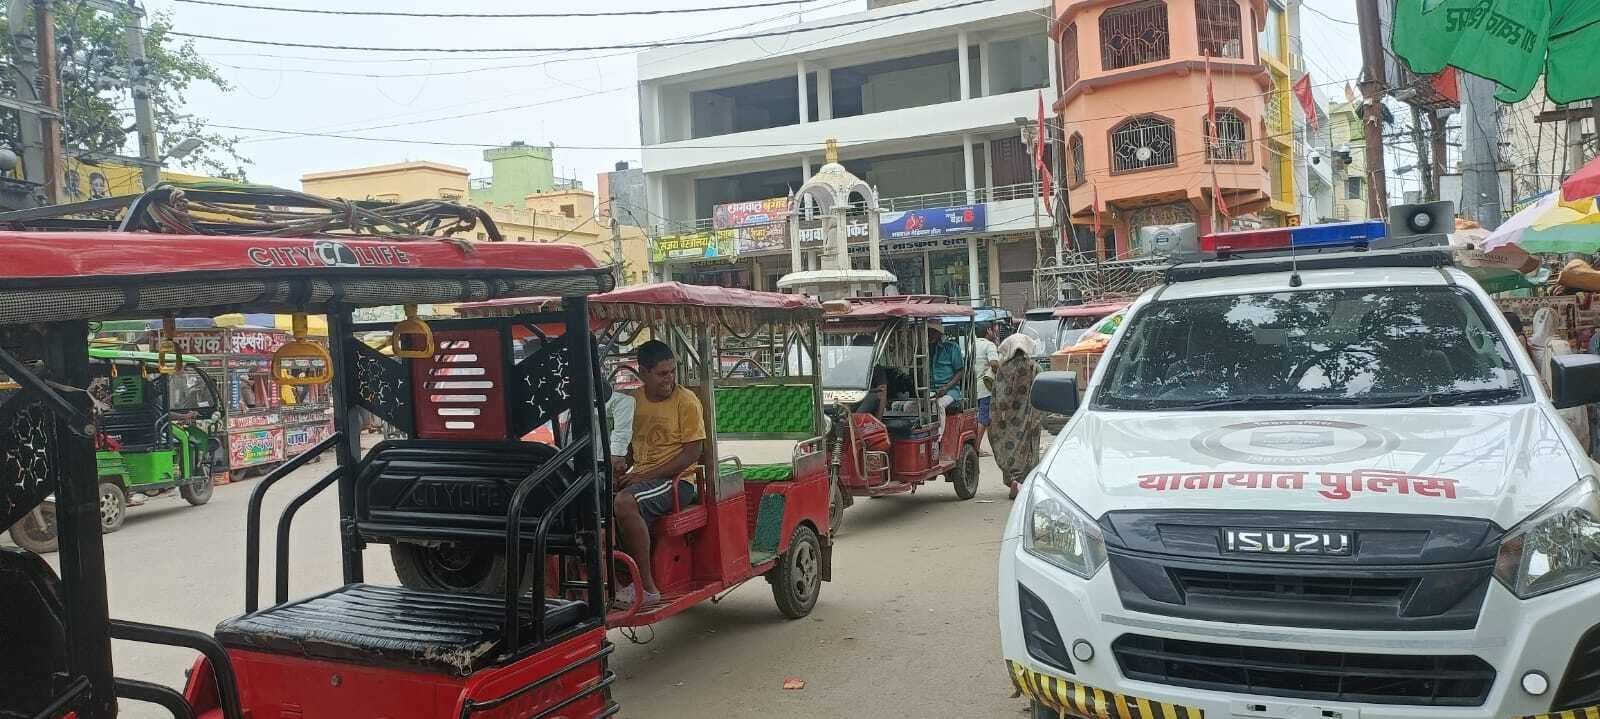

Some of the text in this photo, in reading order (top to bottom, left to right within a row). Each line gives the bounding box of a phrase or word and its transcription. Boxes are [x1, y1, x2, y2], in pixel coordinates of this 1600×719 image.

[247, 247, 315, 266] CITY
[355, 246, 410, 264] LIFE
[1137, 468, 1460, 500] यातायात पुलिस
[1227, 531, 1348, 553] ISUZU
